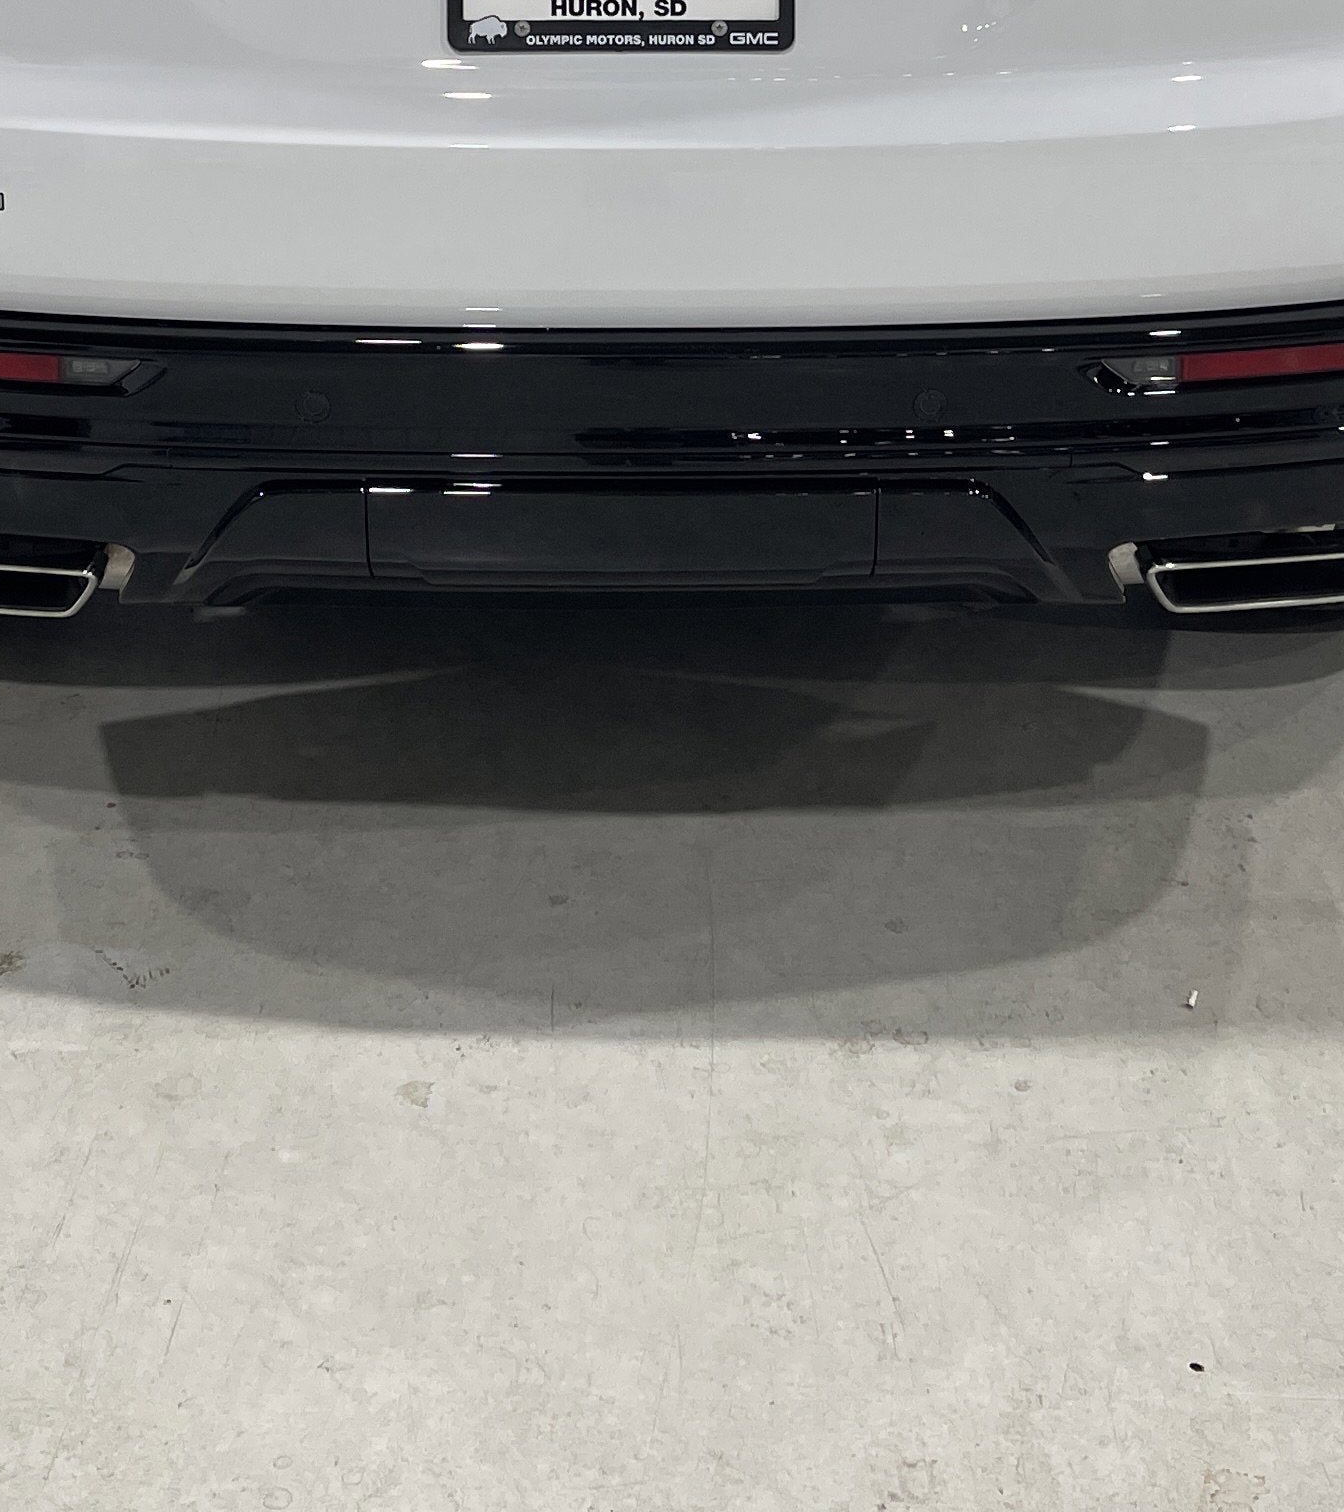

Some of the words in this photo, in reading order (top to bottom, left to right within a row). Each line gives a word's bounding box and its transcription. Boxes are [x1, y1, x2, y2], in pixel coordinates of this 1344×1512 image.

[551, 0, 644, 20] HURON,
[653, 0, 687, 16] SD
[526, 35, 583, 46] OLYMPIC
[586, 35, 645, 47] MOTORS,
[649, 35, 694, 46] HURON
[697, 35, 716, 46] SD
[729, 32, 779, 45] GMC
